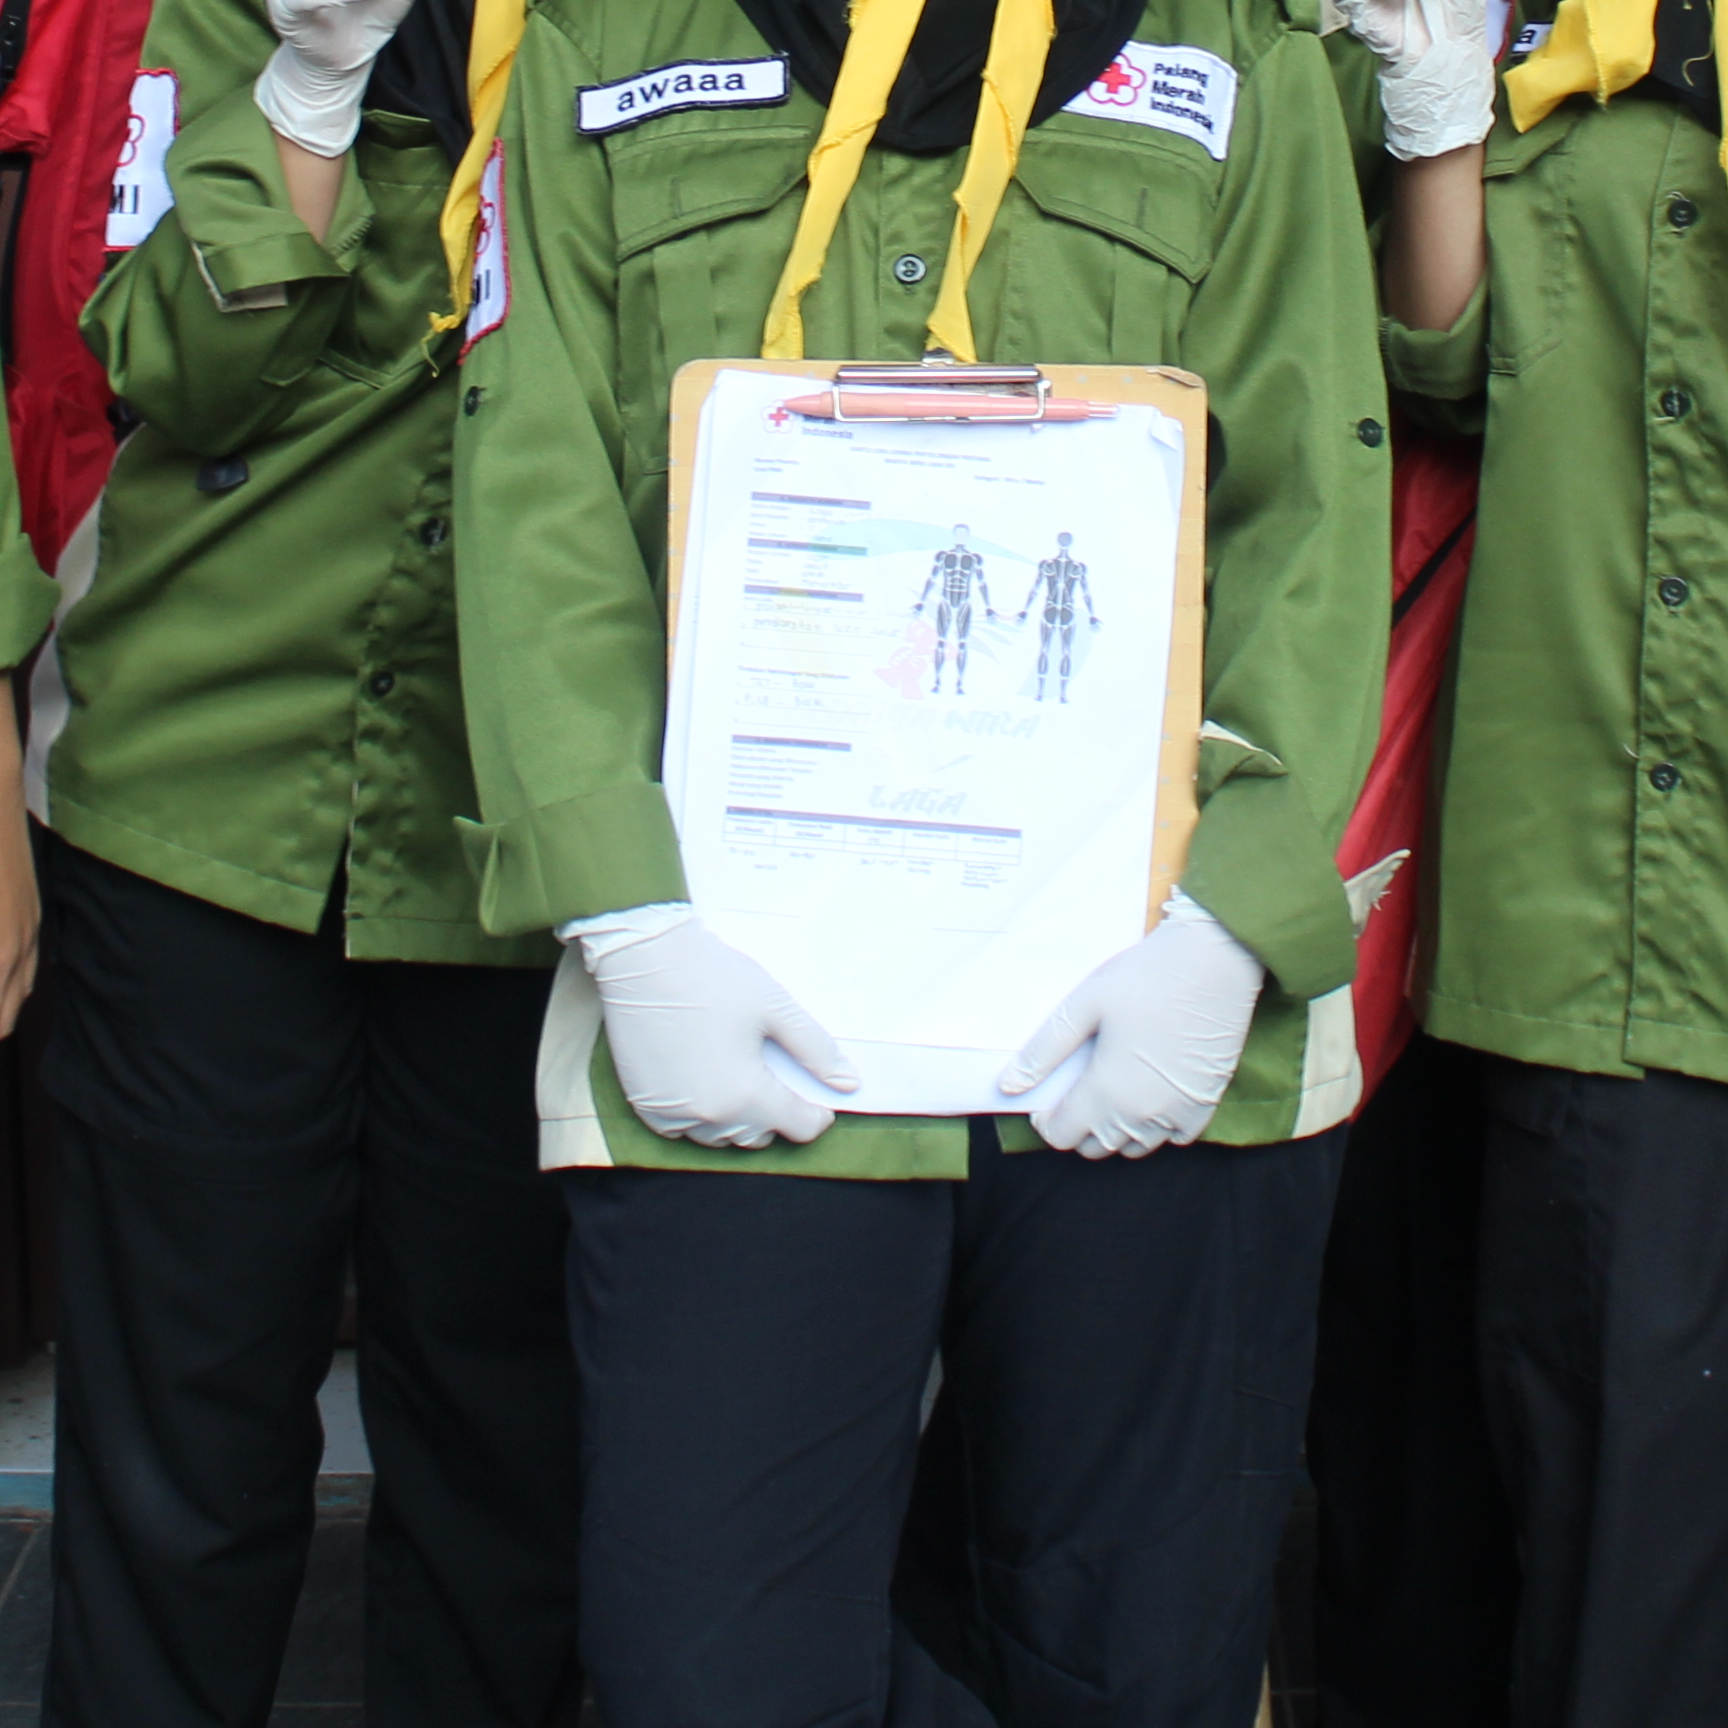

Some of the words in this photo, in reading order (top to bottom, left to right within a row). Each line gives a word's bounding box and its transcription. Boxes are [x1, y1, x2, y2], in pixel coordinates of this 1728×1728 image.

[1153, 62, 1209, 88] Palang
[616, 73, 746, 112] awaaa
[1152, 80, 1205, 106] Merah
